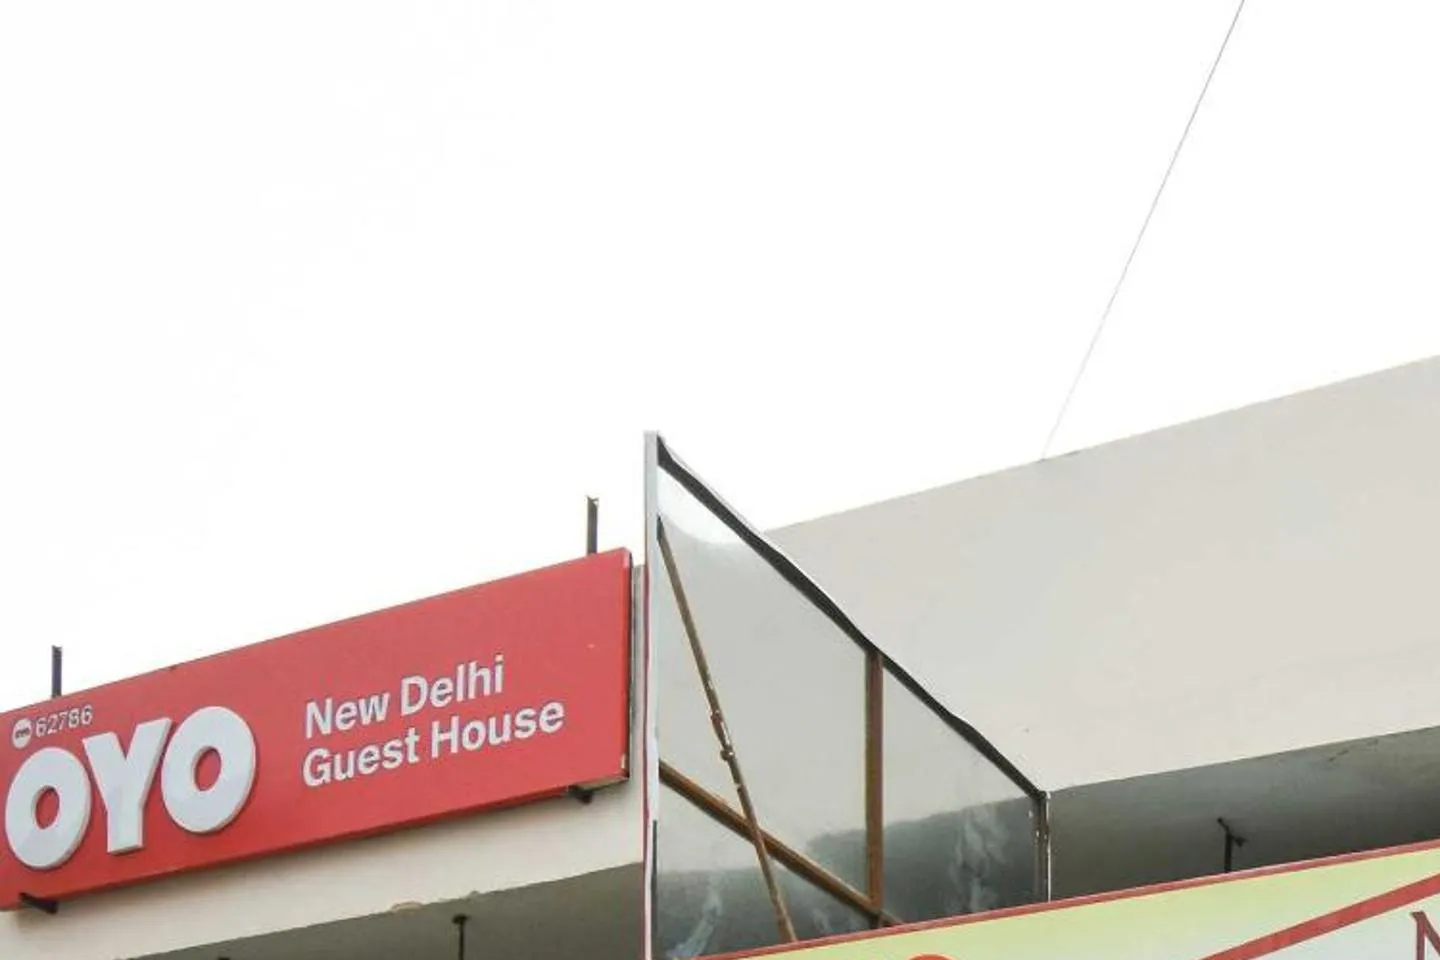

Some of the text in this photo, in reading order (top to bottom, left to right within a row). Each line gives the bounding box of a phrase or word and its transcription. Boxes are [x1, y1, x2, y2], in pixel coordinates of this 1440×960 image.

[305, 654, 504, 738] New Delhi
[302, 702, 565, 787] Guest House
[5, 706, 257, 870] OYO
